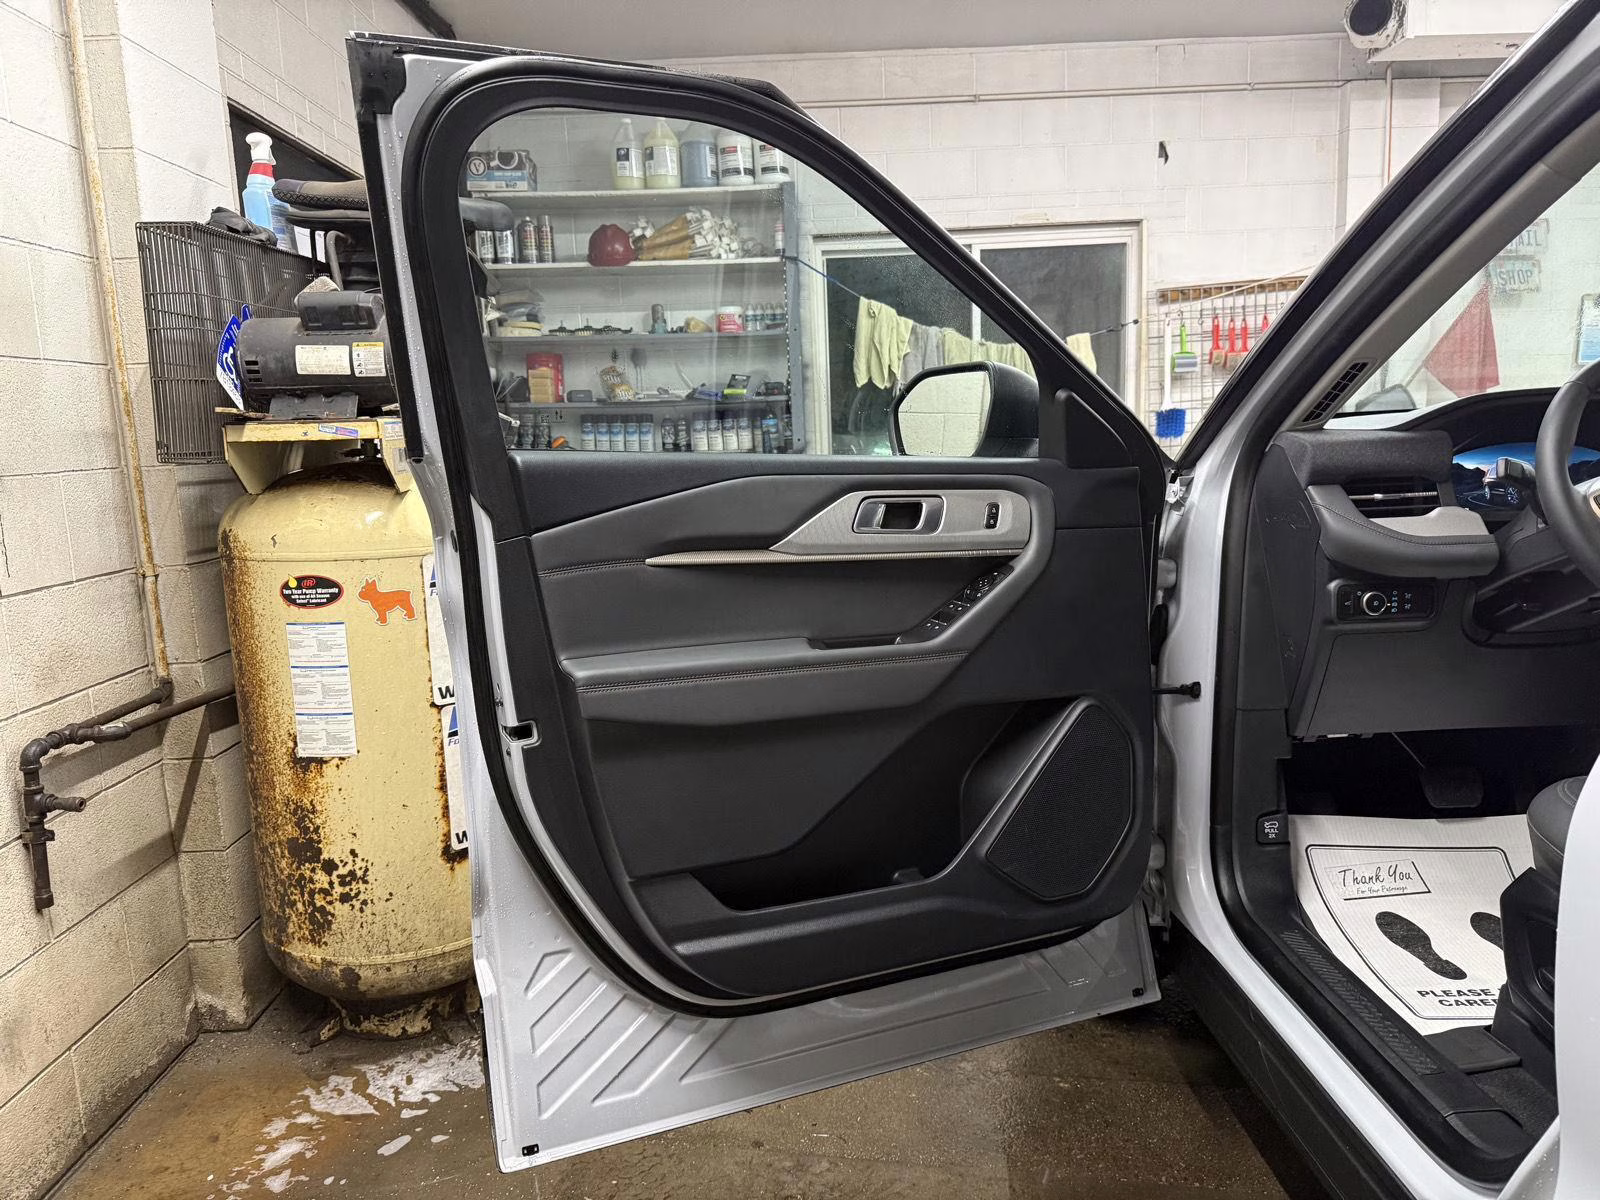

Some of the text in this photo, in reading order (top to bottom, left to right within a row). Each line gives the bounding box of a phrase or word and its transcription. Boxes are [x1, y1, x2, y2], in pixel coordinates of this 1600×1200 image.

[1498, 269, 1533, 286] SHOP
[1338, 863, 1413, 887] Thank You
[1416, 989, 1496, 997] PLEASE
